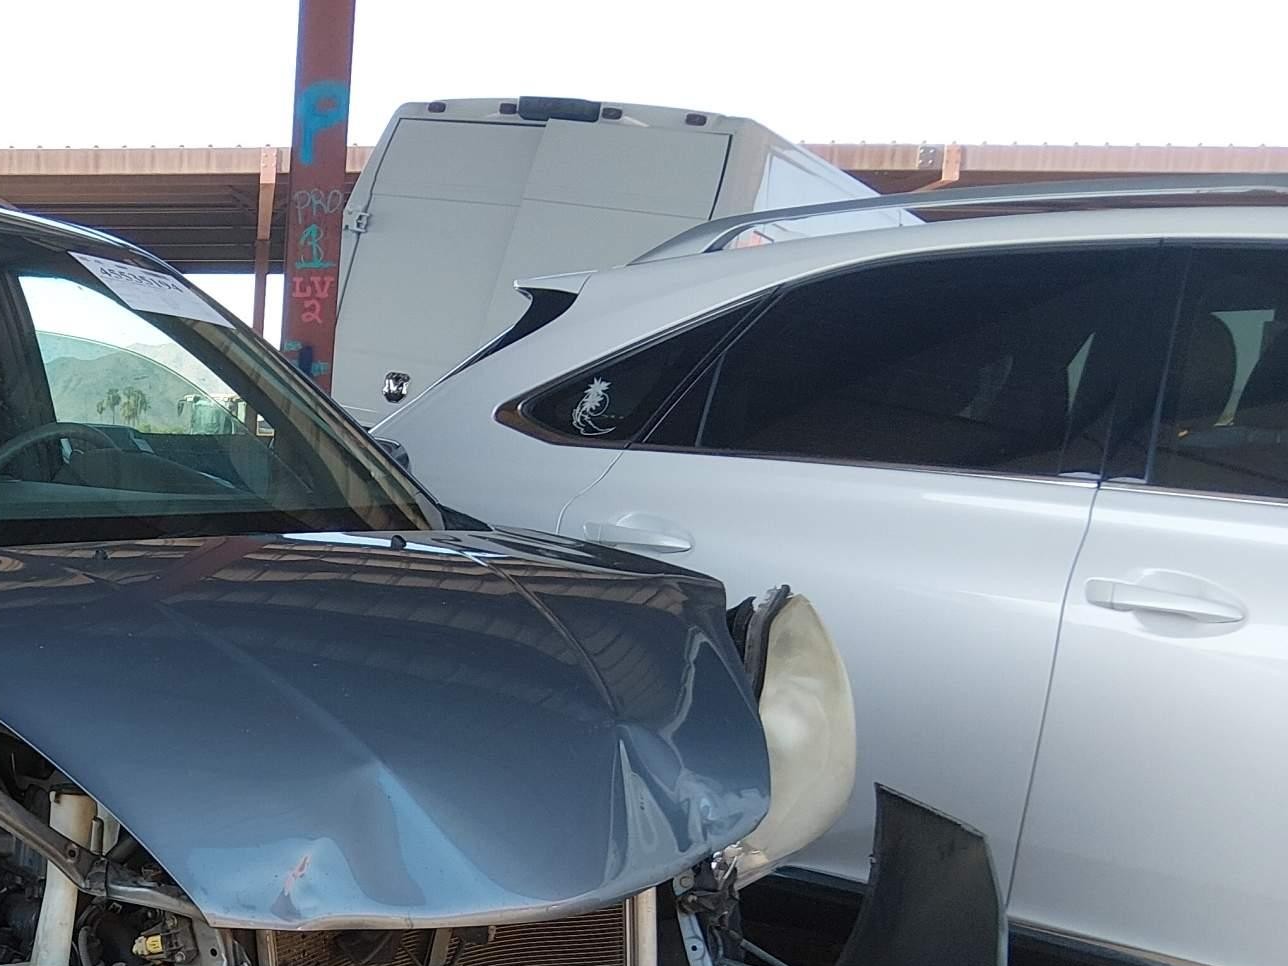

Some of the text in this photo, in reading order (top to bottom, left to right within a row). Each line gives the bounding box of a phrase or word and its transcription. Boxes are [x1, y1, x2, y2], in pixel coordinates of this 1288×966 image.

[295, 81, 349, 165] P
[294, 188, 343, 224] PRO
[292, 276, 335, 298] LV
[300, 299, 323, 324] 2
